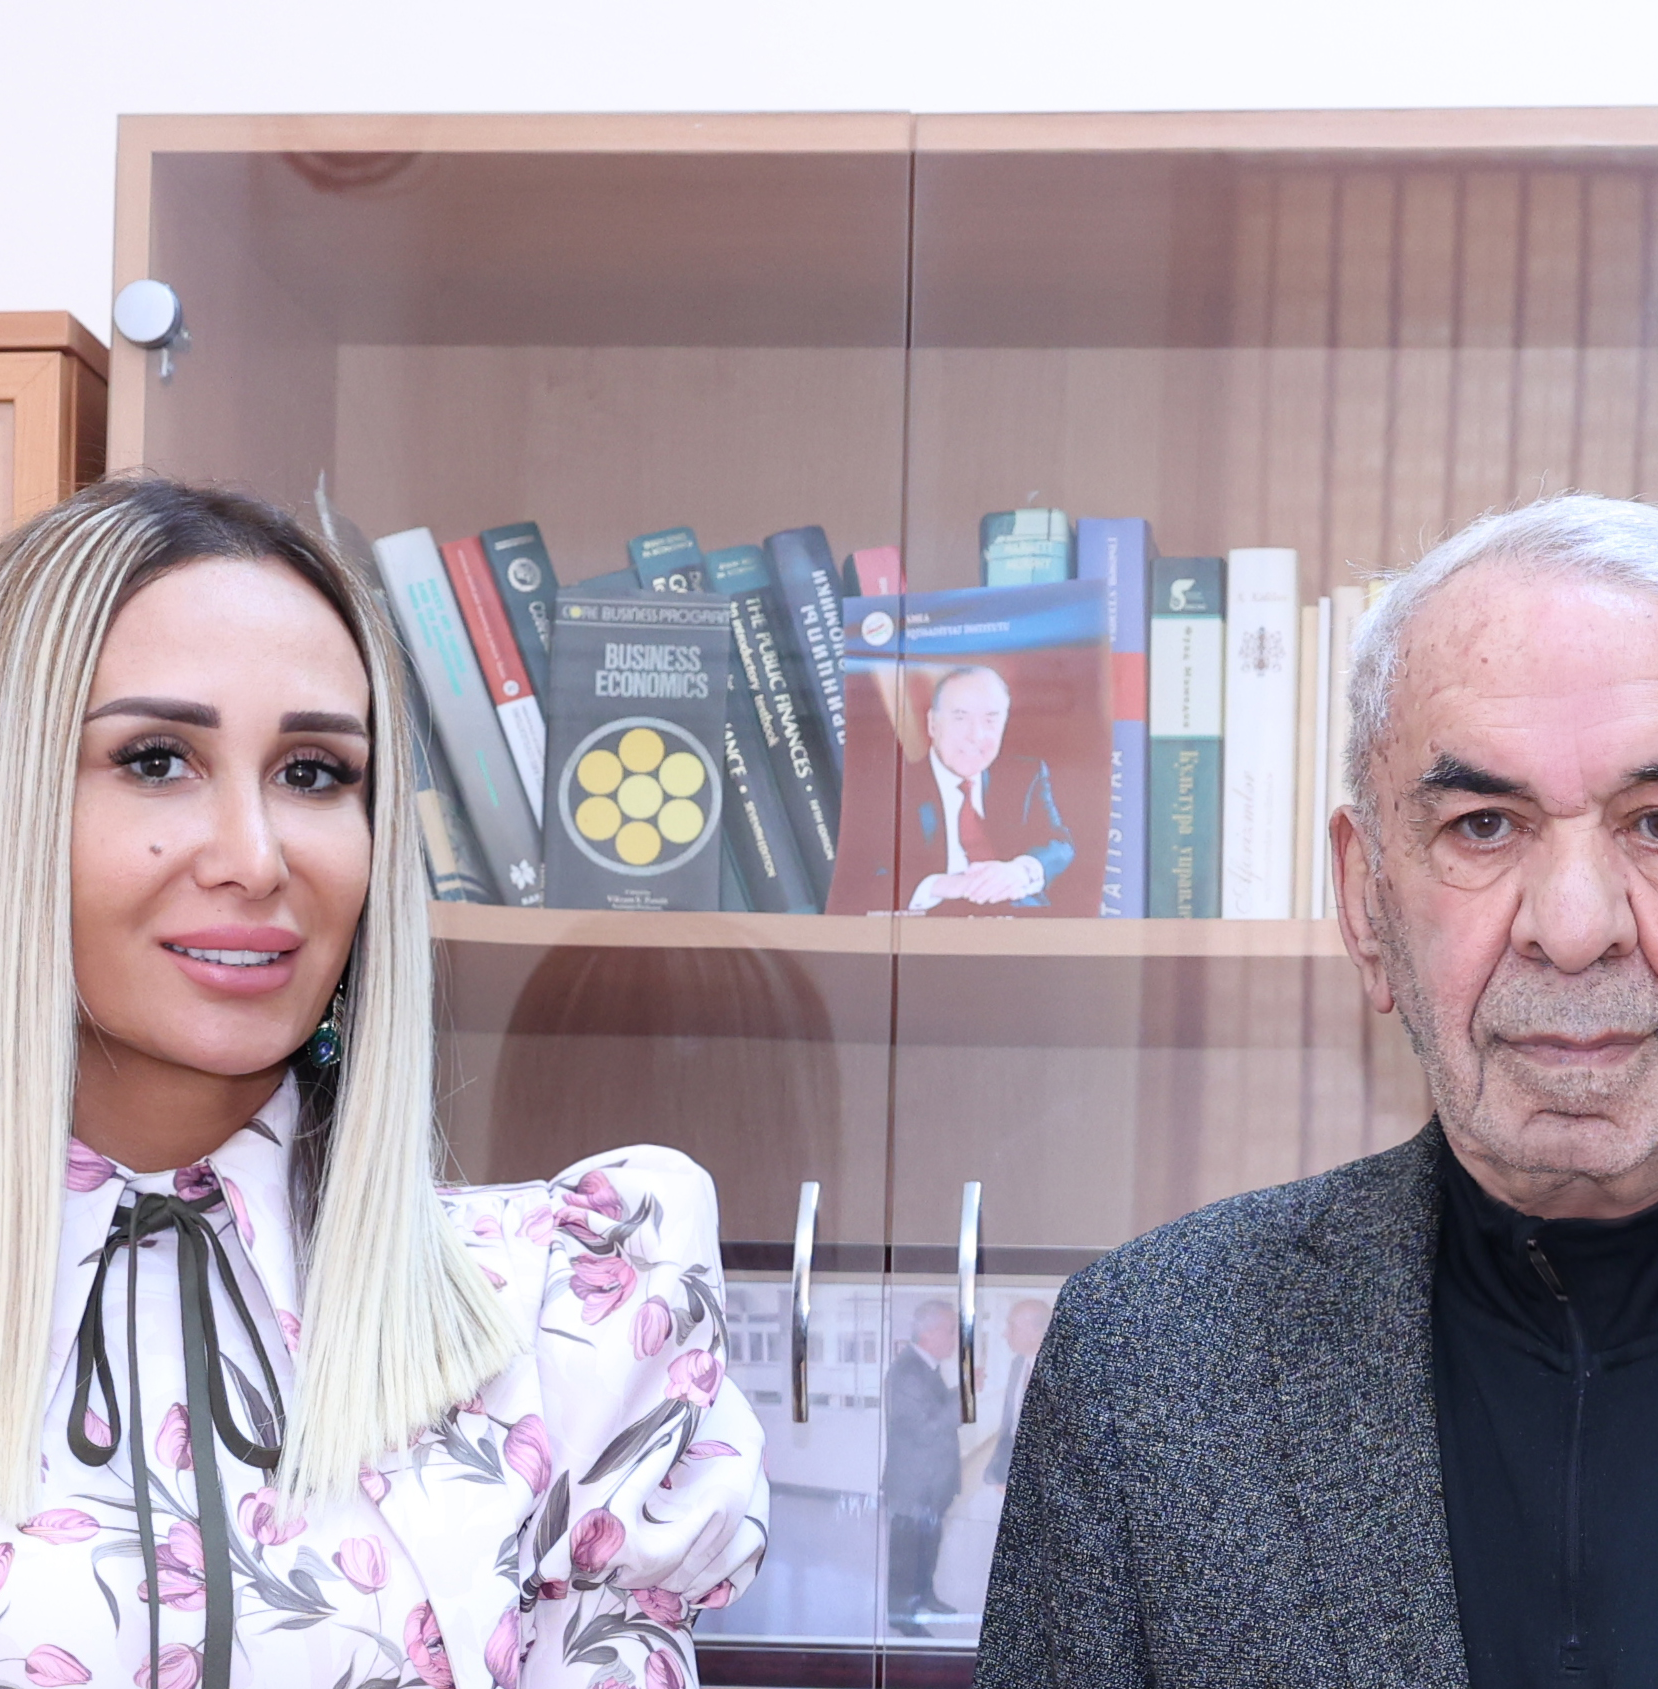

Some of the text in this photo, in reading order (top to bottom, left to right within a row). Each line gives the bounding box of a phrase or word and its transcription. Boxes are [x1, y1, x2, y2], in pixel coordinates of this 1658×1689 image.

[601, 605, 656, 622] BUSINESS
[742, 595, 767, 629] THE
[594, 669, 709, 700] ECONOMICS
[604, 642, 702, 673] BUSINESS
[731, 616, 762, 690] introductory
[757, 691, 780, 747] textbook
[752, 629, 787, 692] PUBLIC
[721, 721, 748, 780] ANCE
[771, 690, 814, 780] FINANCES
[1171, 750, 1198, 834] Культура
